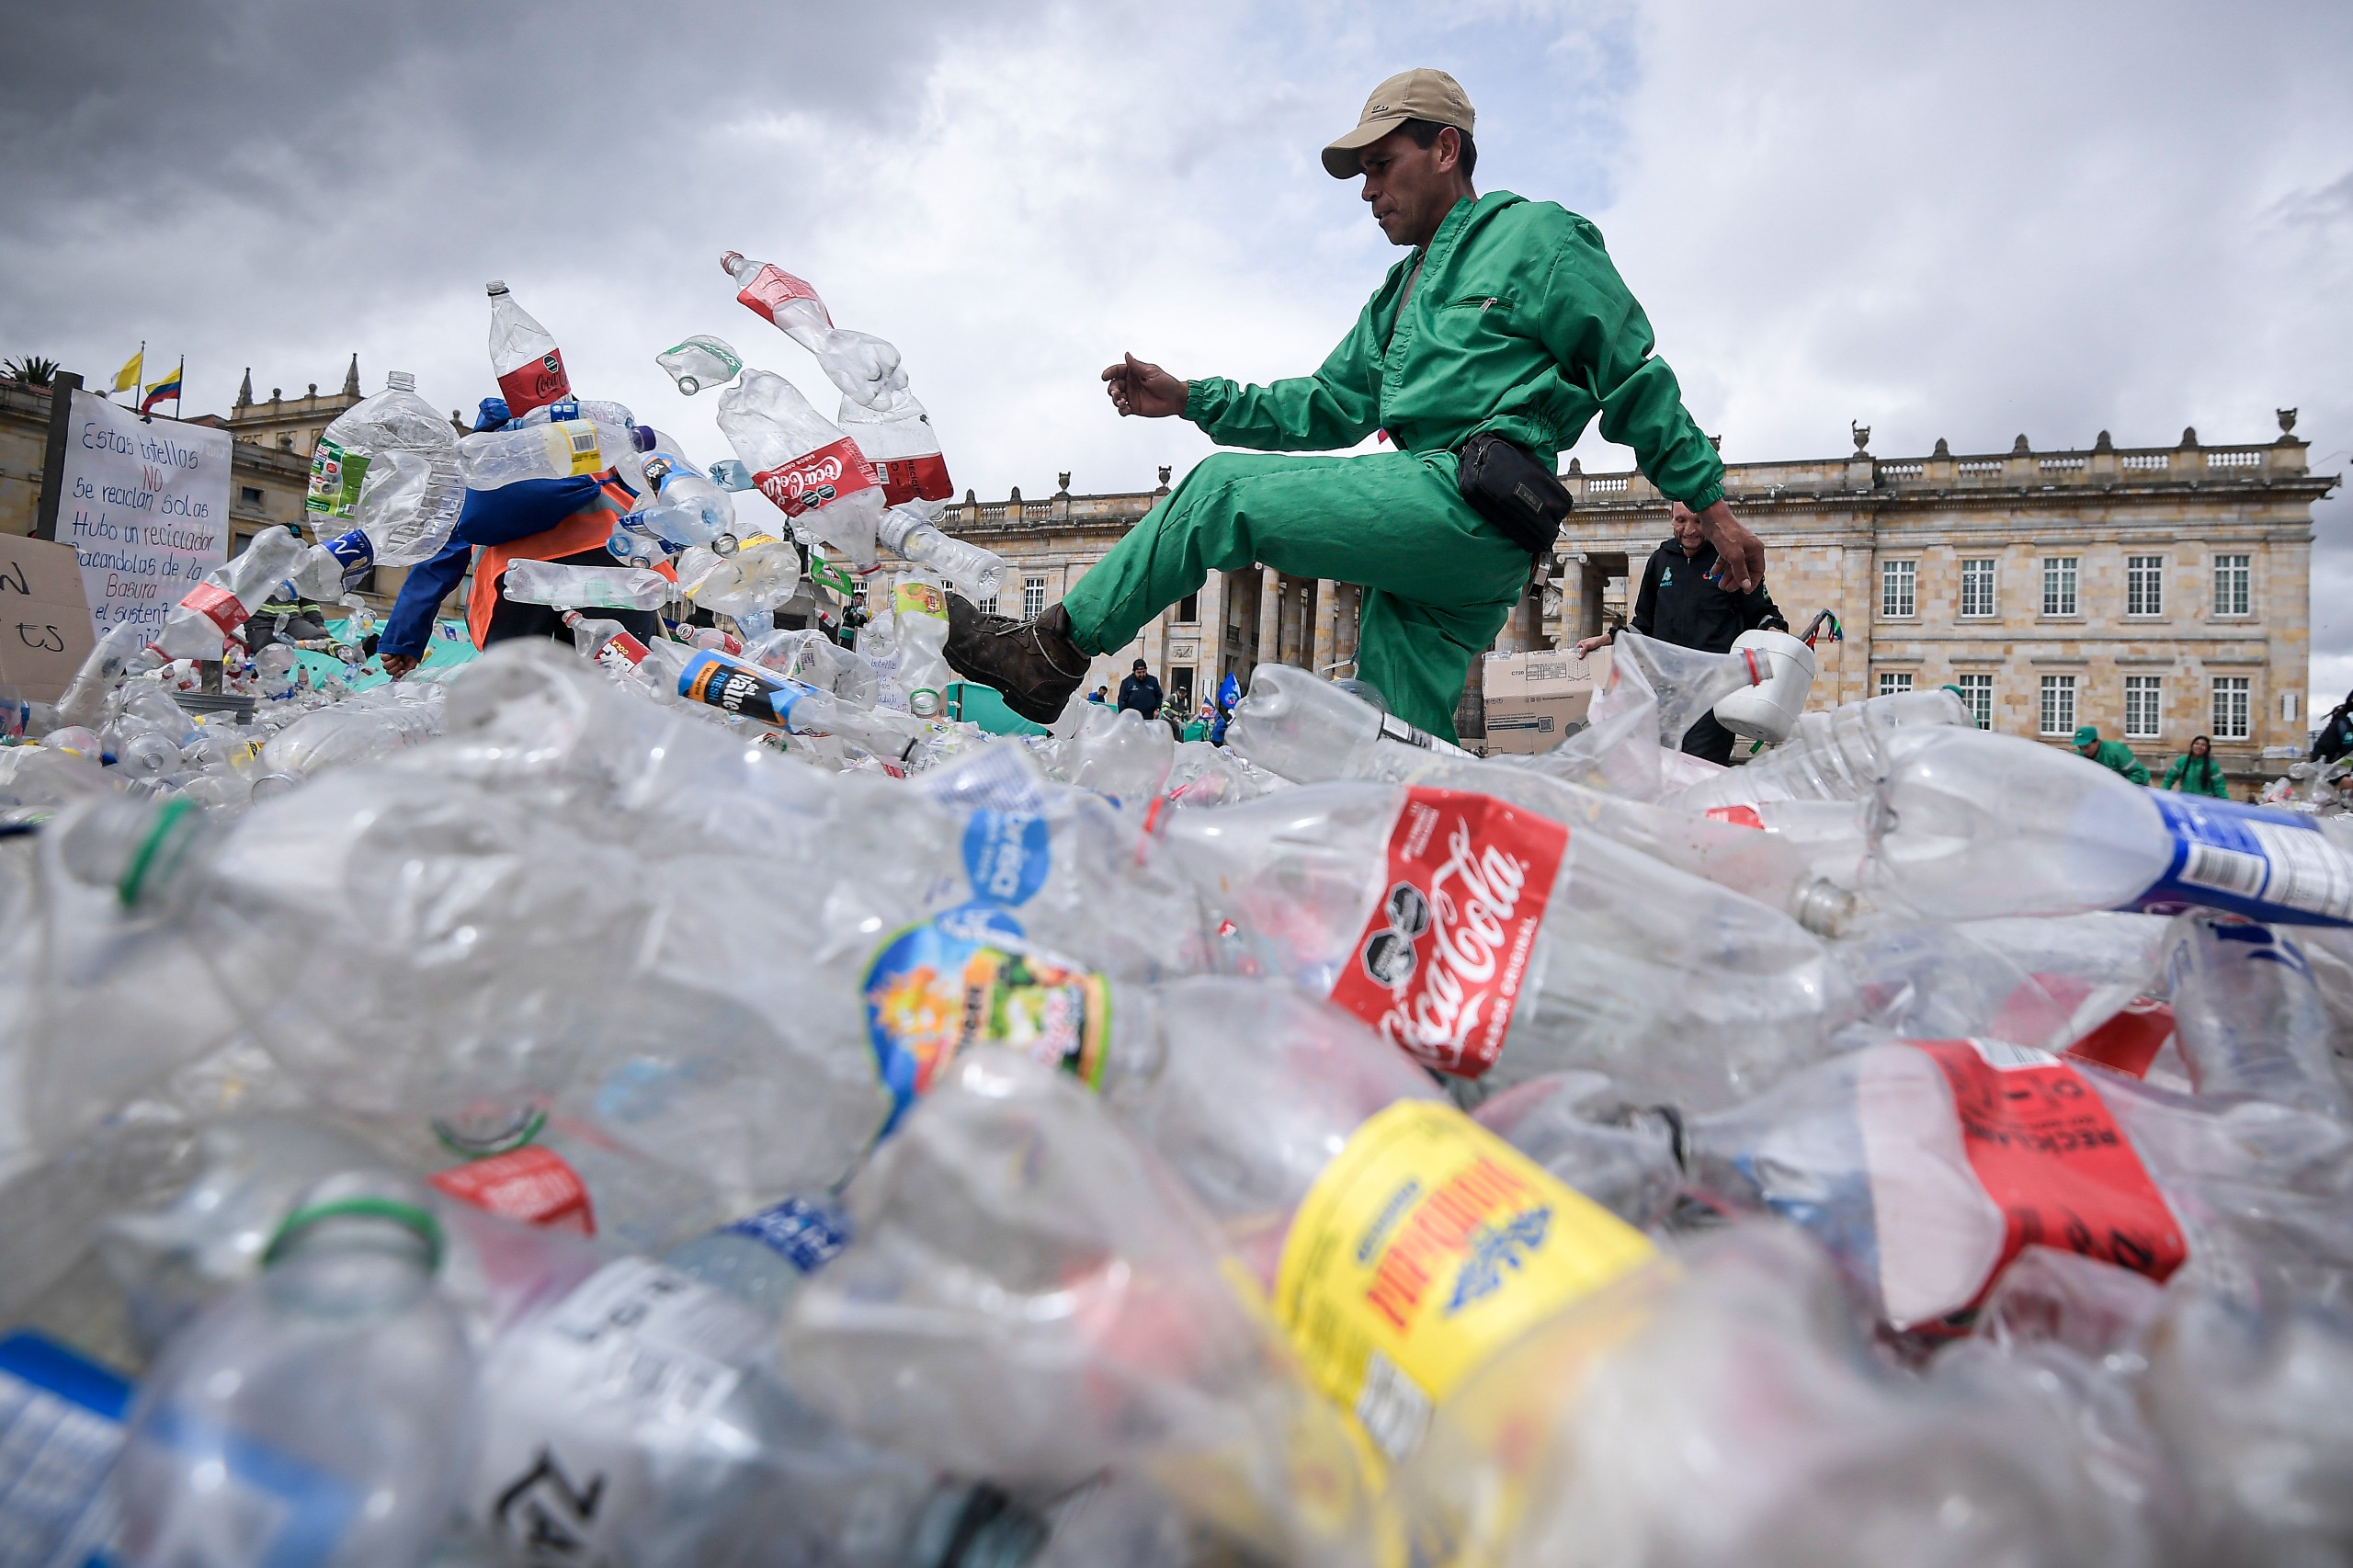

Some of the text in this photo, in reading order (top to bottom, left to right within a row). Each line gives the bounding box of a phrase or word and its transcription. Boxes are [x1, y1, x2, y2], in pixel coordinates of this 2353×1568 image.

[82, 422, 134, 455] Estas
[143, 464, 164, 493] NO
[102, 486, 153, 511] reciclan
[73, 511, 215, 551] Hubo un reciclador
[162, 552, 179, 576] de
[187, 557, 203, 581] la
[106, 574, 157, 598] Basura
[96, 603, 109, 620] el
[611, 639, 630, 655] COLA
[709, 671, 729, 701] FRESH
[745, 682, 761, 697] del
[1380, 813, 1528, 1069] Coca-Cola
[1479, 915, 1539, 1060] SABOR ORIGINAL
